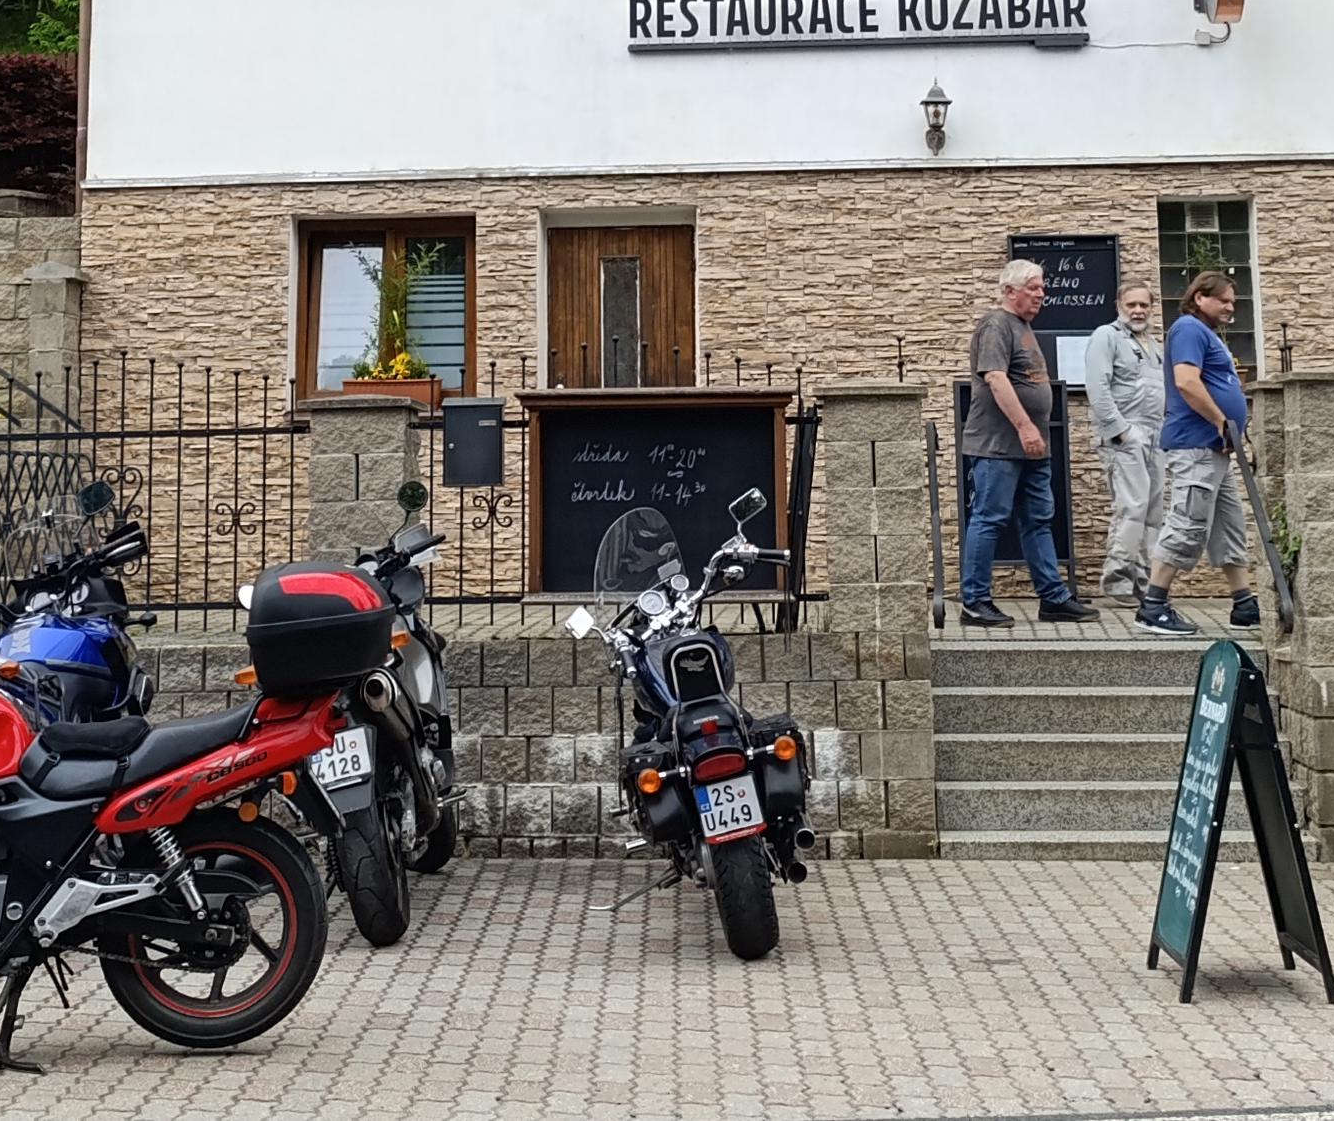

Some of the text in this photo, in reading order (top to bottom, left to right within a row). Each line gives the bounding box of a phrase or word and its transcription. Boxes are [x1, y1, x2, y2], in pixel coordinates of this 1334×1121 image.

[1042, 293, 1105, 307] CHLOSSEN
[207, 751, 267, 781] CB500
[316, 754, 362, 780] 4128
[711, 785, 735, 807] 2S
[704, 804, 753, 832] U449
